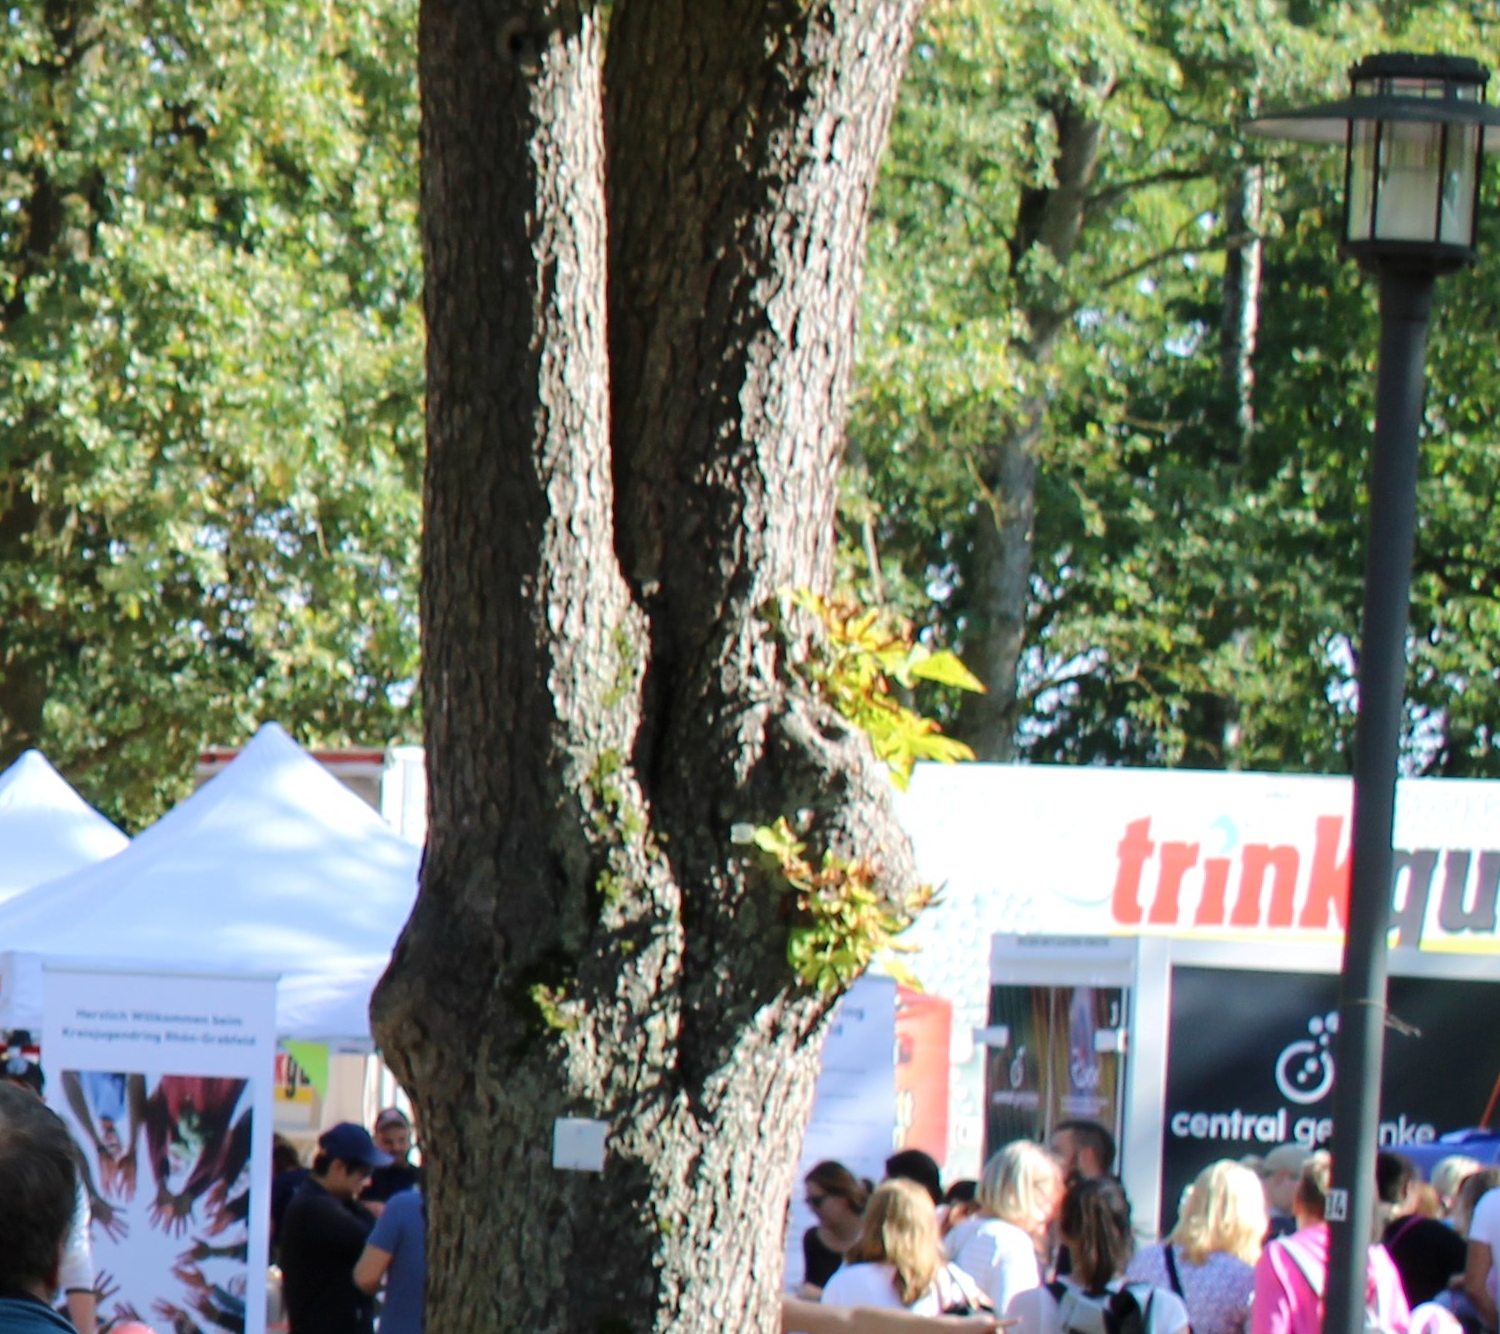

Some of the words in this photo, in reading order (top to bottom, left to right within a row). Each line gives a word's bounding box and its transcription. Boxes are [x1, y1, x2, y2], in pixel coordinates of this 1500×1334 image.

[1111, 815, 1500, 951] trinkgu
[1171, 1107, 1287, 1142] central
[1293, 1114, 1437, 1151] genke
